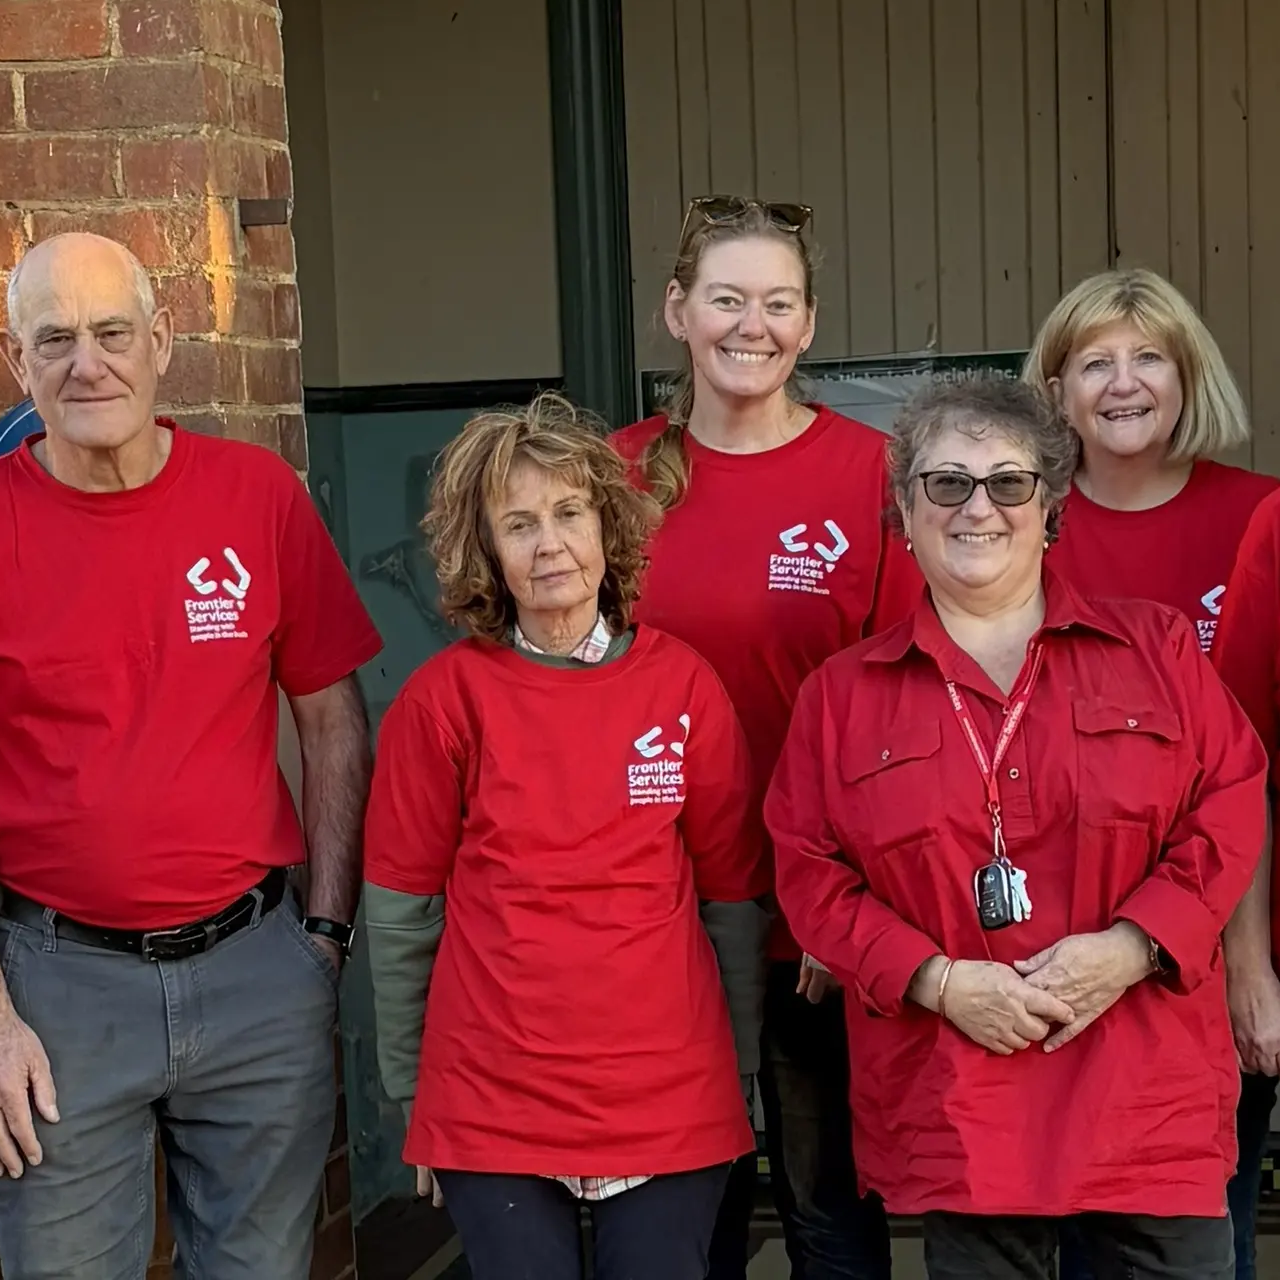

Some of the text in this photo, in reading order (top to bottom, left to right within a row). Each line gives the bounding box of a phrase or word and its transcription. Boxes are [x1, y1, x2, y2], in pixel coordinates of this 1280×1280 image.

[770, 554, 823, 568] Frontier
[769, 564, 824, 579] Services
[184, 597, 234, 612] Frontier
[187, 608, 240, 624] Services
[628, 759, 683, 776] Frontier
[628, 770, 685, 787] Services
